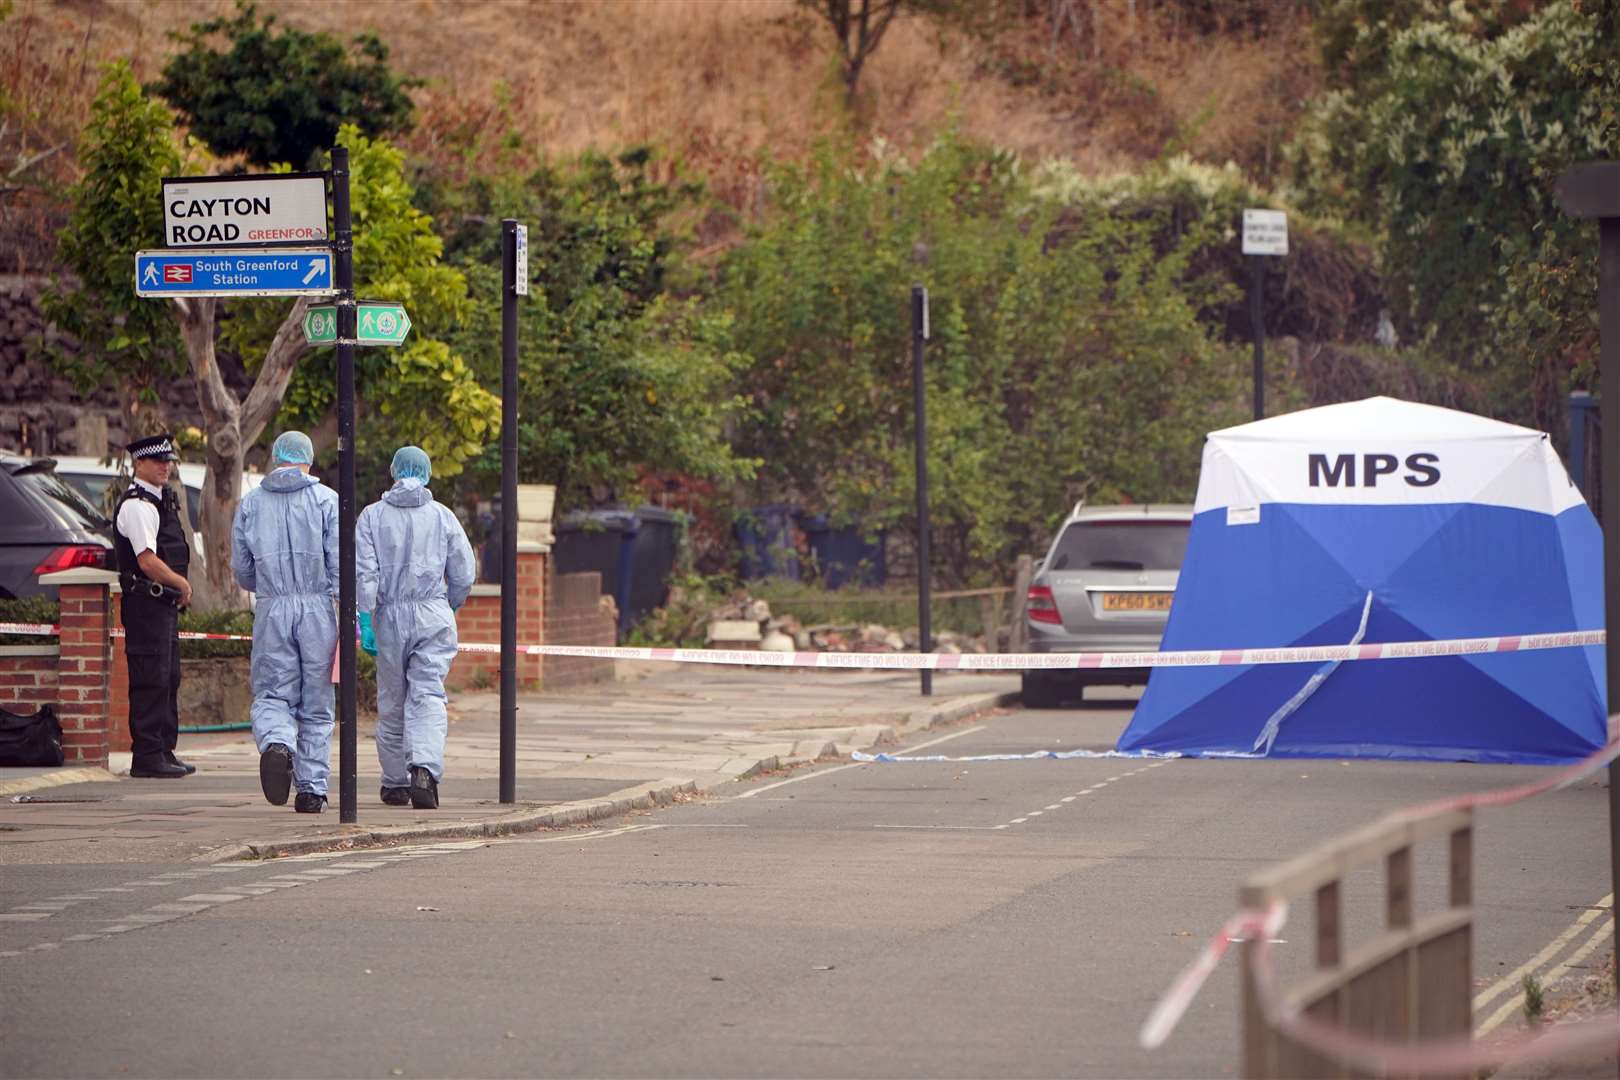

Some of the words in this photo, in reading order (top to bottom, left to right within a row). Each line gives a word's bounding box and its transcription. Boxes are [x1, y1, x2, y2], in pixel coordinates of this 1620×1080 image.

[170, 197, 271, 218] CAYTON
[172, 223, 240, 243] ROAD
[196, 260, 232, 272] South
[236, 260, 298, 272] Greenford
[213, 274, 257, 285] Station
[1308, 453, 1442, 487] MPS
